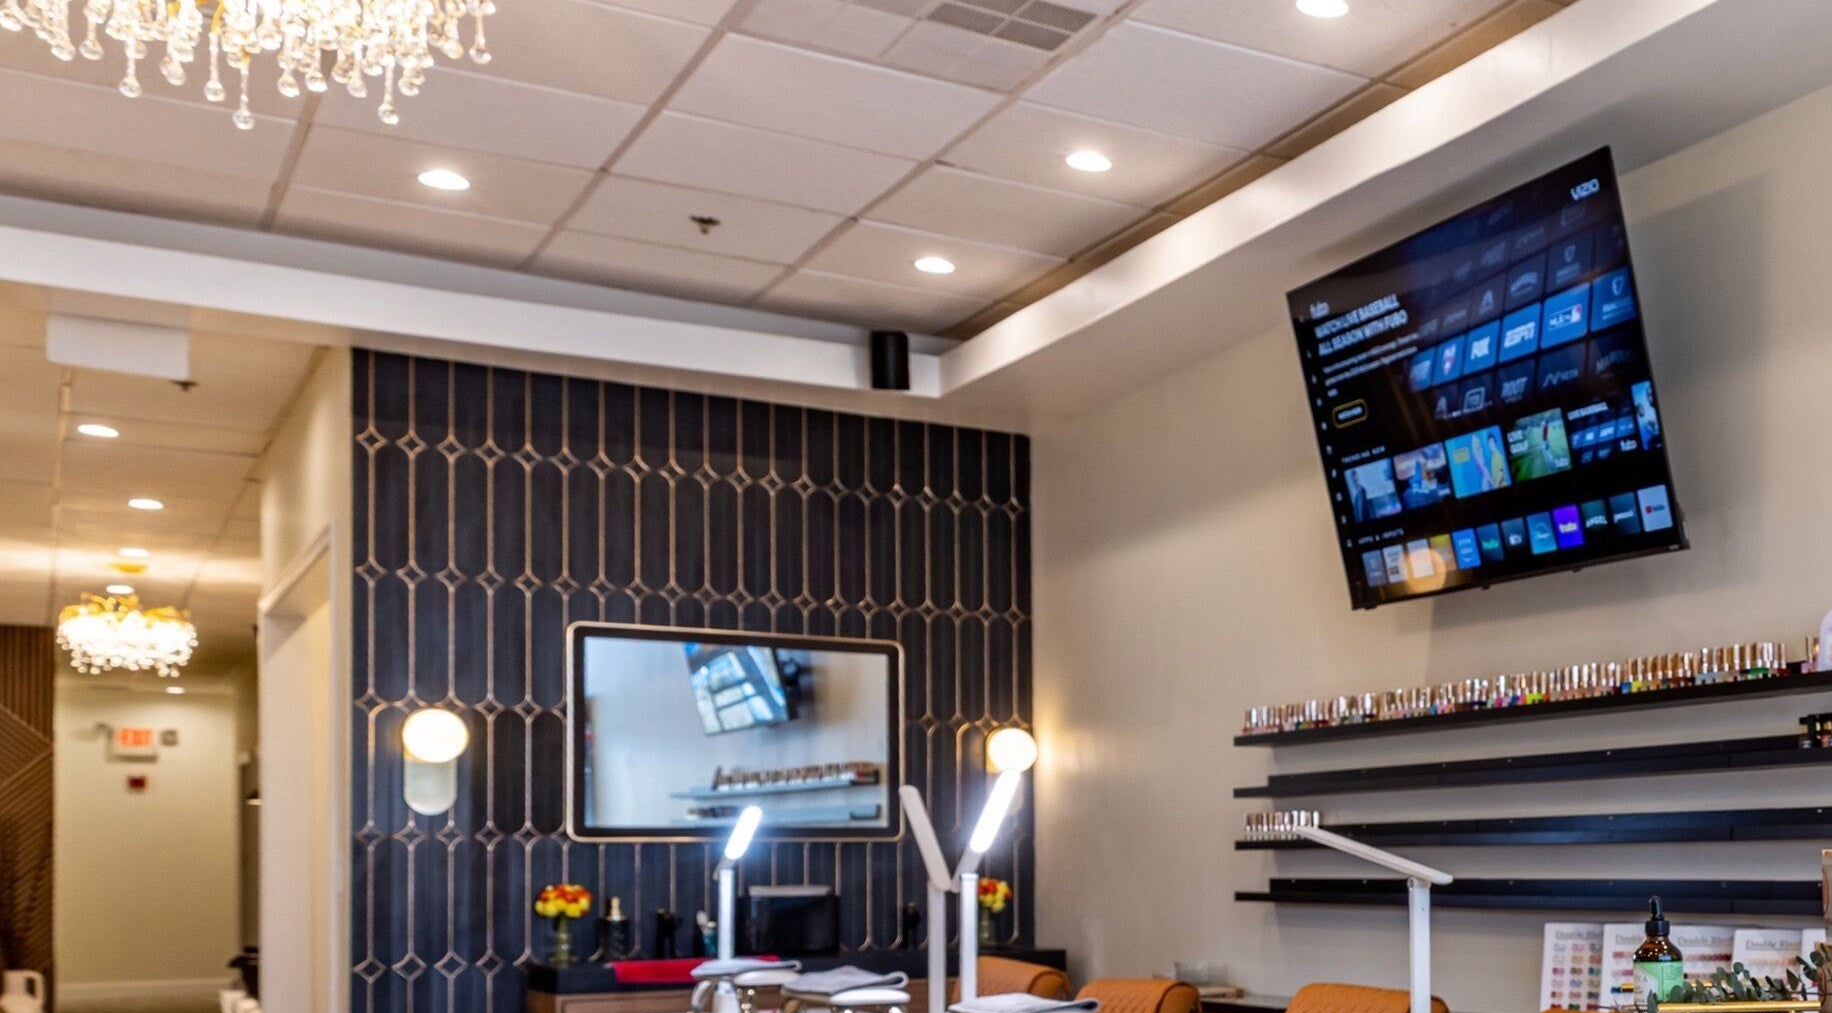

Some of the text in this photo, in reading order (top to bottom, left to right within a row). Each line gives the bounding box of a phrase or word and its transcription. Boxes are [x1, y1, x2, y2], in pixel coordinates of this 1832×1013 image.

[1570, 178, 1600, 201] VIZIO
[1358, 293, 1400, 322] BASEBALL
[1318, 309, 1409, 357] ALL SEASON WITH FUBO
[1503, 321, 1536, 348] ESPN
[1470, 336, 1490, 360] FOX
